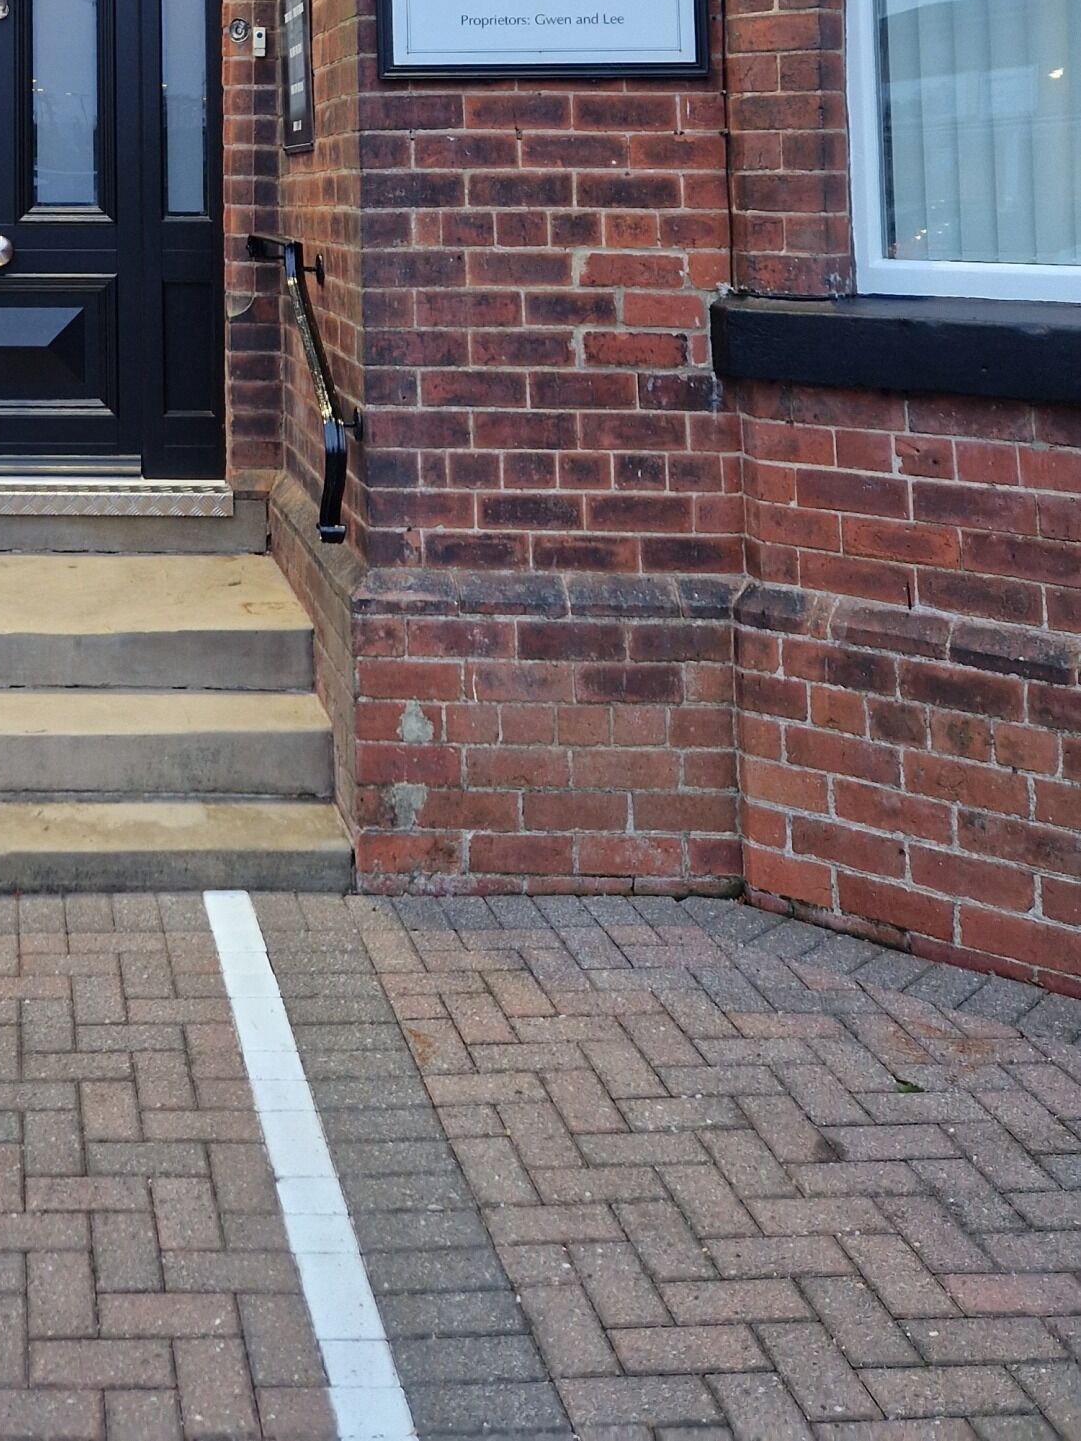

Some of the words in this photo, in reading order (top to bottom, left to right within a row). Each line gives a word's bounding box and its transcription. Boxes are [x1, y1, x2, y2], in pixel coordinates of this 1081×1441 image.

[460, 14, 531, 29] Proprietors:
[534, 13, 572, 25] Gwen
[575, 13, 599, 25] and
[603, 13, 625, 25] Lee
